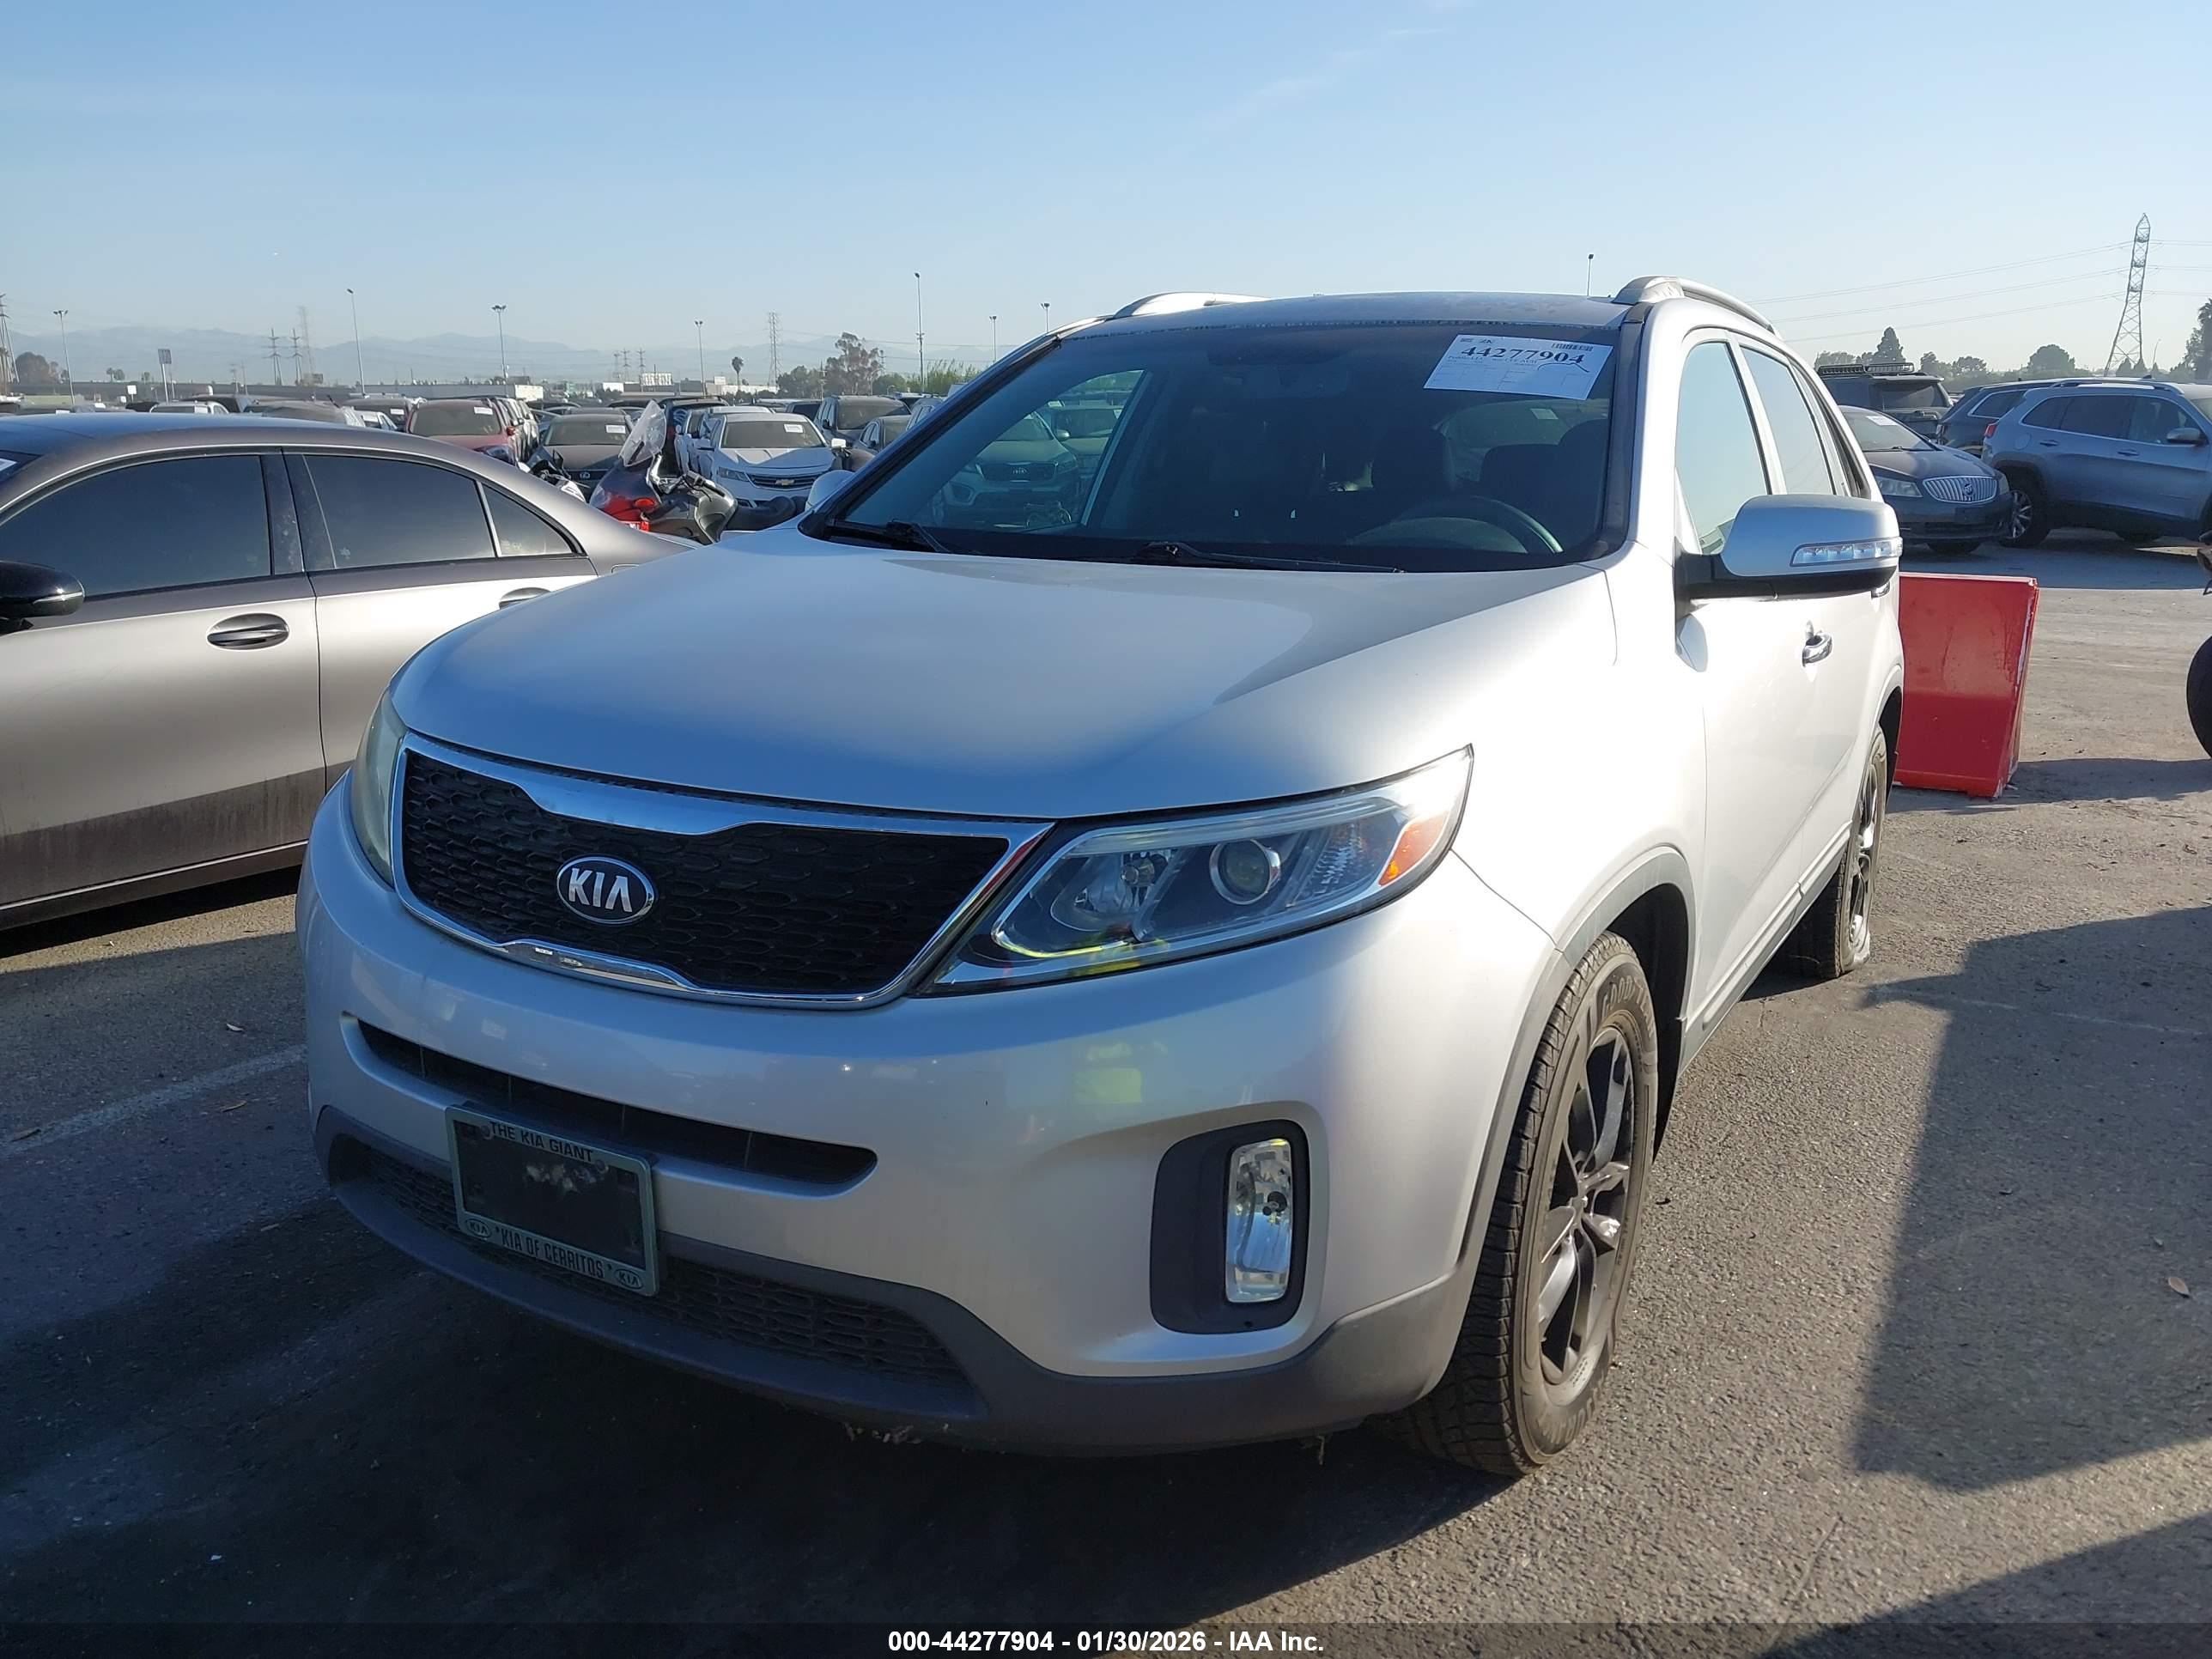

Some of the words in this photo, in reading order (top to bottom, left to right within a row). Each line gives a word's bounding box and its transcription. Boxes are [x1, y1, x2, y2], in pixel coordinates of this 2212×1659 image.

[1462, 346, 1585, 364] 44277904
[568, 868, 633, 912] KIA
[489, 1121, 516, 1140] THE
[520, 1130, 544, 1149] KIA
[549, 1139, 593, 1163] GIANT
[501, 1228, 522, 1252] KIA
[526, 1237, 539, 1256] OF
[544, 1243, 605, 1279] CERRITOS
[619, 1273, 639, 1287] KIA
